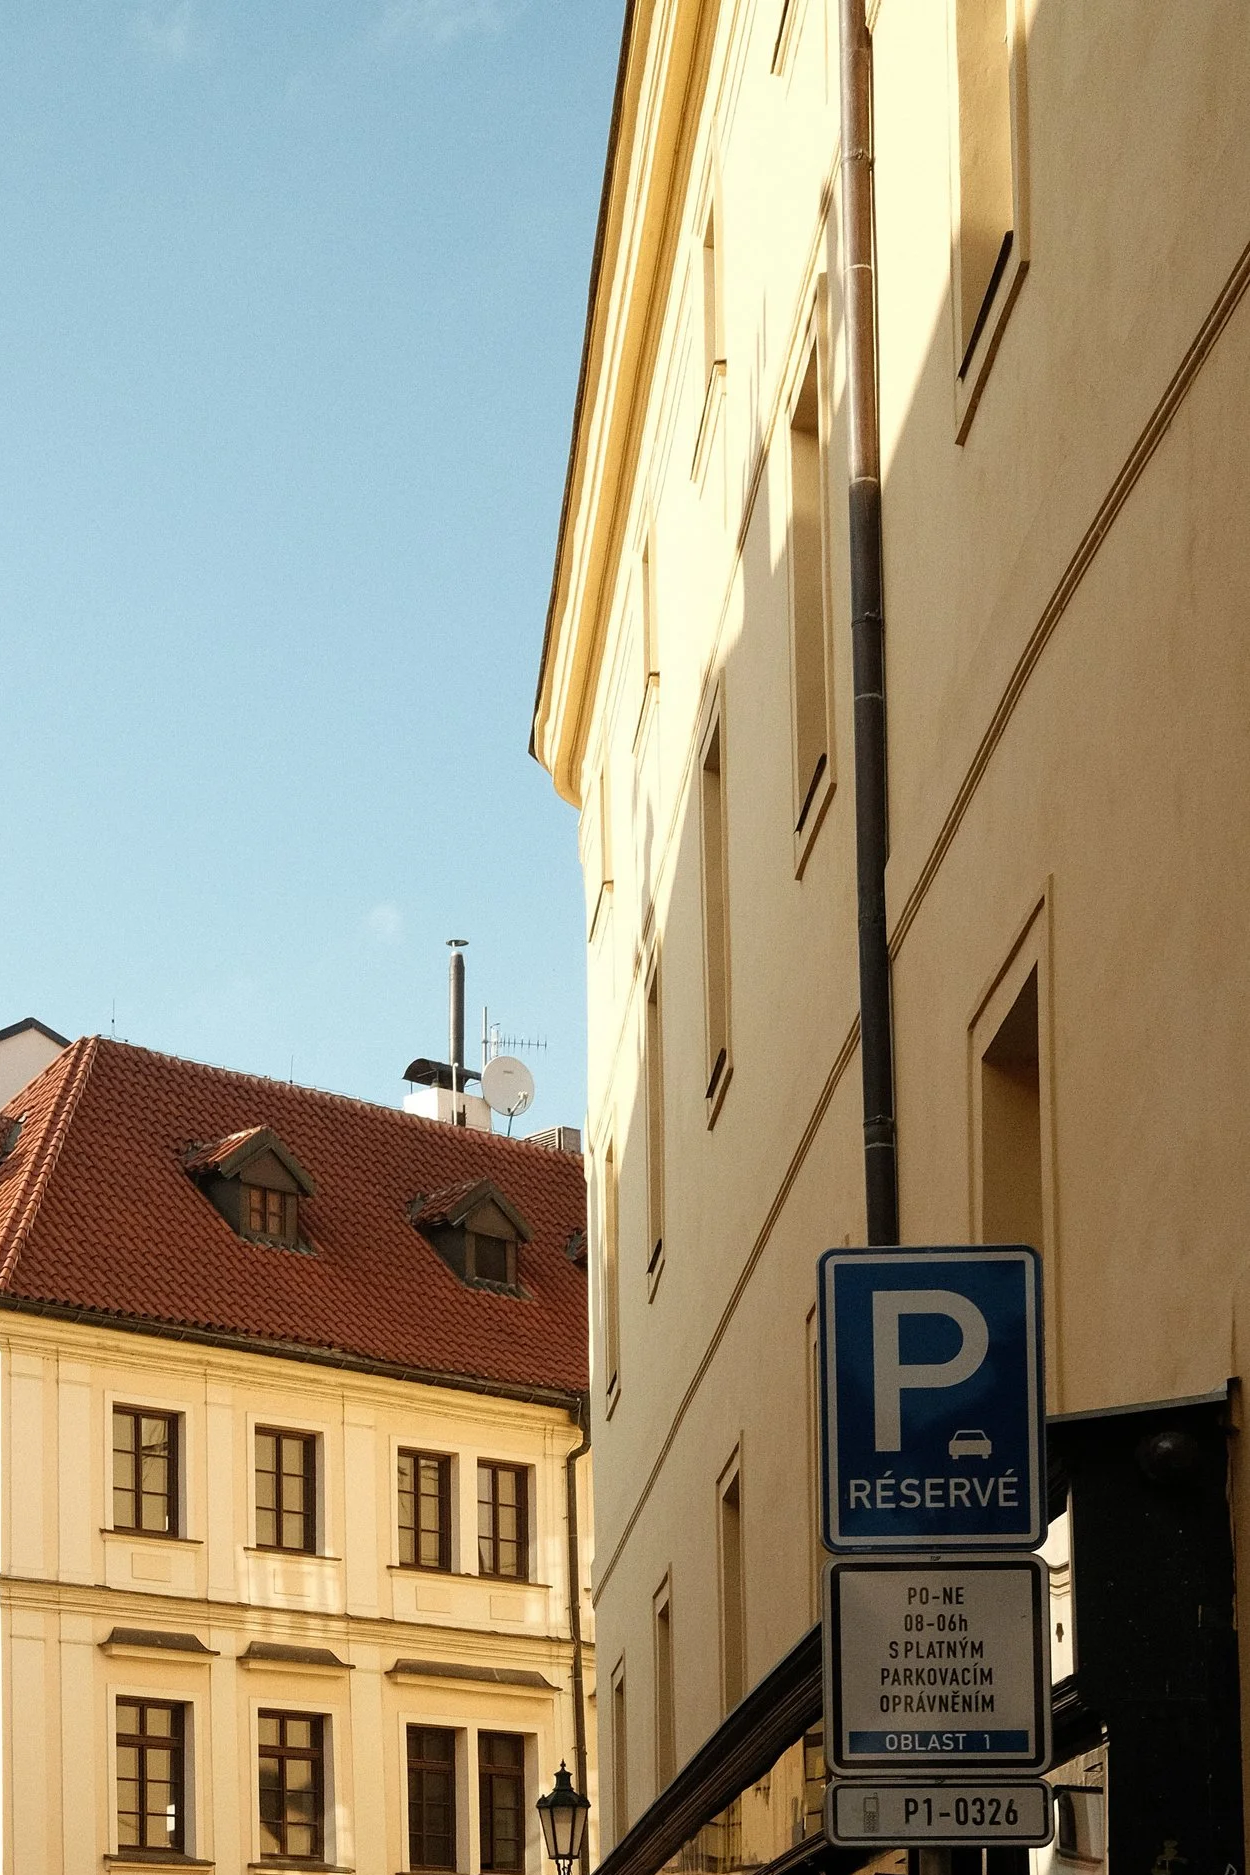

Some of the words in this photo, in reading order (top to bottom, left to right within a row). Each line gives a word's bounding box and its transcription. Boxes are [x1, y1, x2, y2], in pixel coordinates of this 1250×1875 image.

[872, 1289, 989, 1453] P
[849, 1468, 1019, 1509] RÉSERVÉ
[907, 1586, 965, 1605] PO-NE
[904, 1613, 968, 1632] 08-06h
[888, 1640, 899, 1660] S
[904, 1635, 984, 1659] PLATNÝM
[880, 1662, 993, 1686] PARKOVACÍM
[879, 1690, 995, 1713] OPRÁVNĚNÍM
[885, 1733, 967, 1751] OBLAST
[983, 1734, 990, 1750] 1
[904, 1797, 1019, 1827] P1-0326
